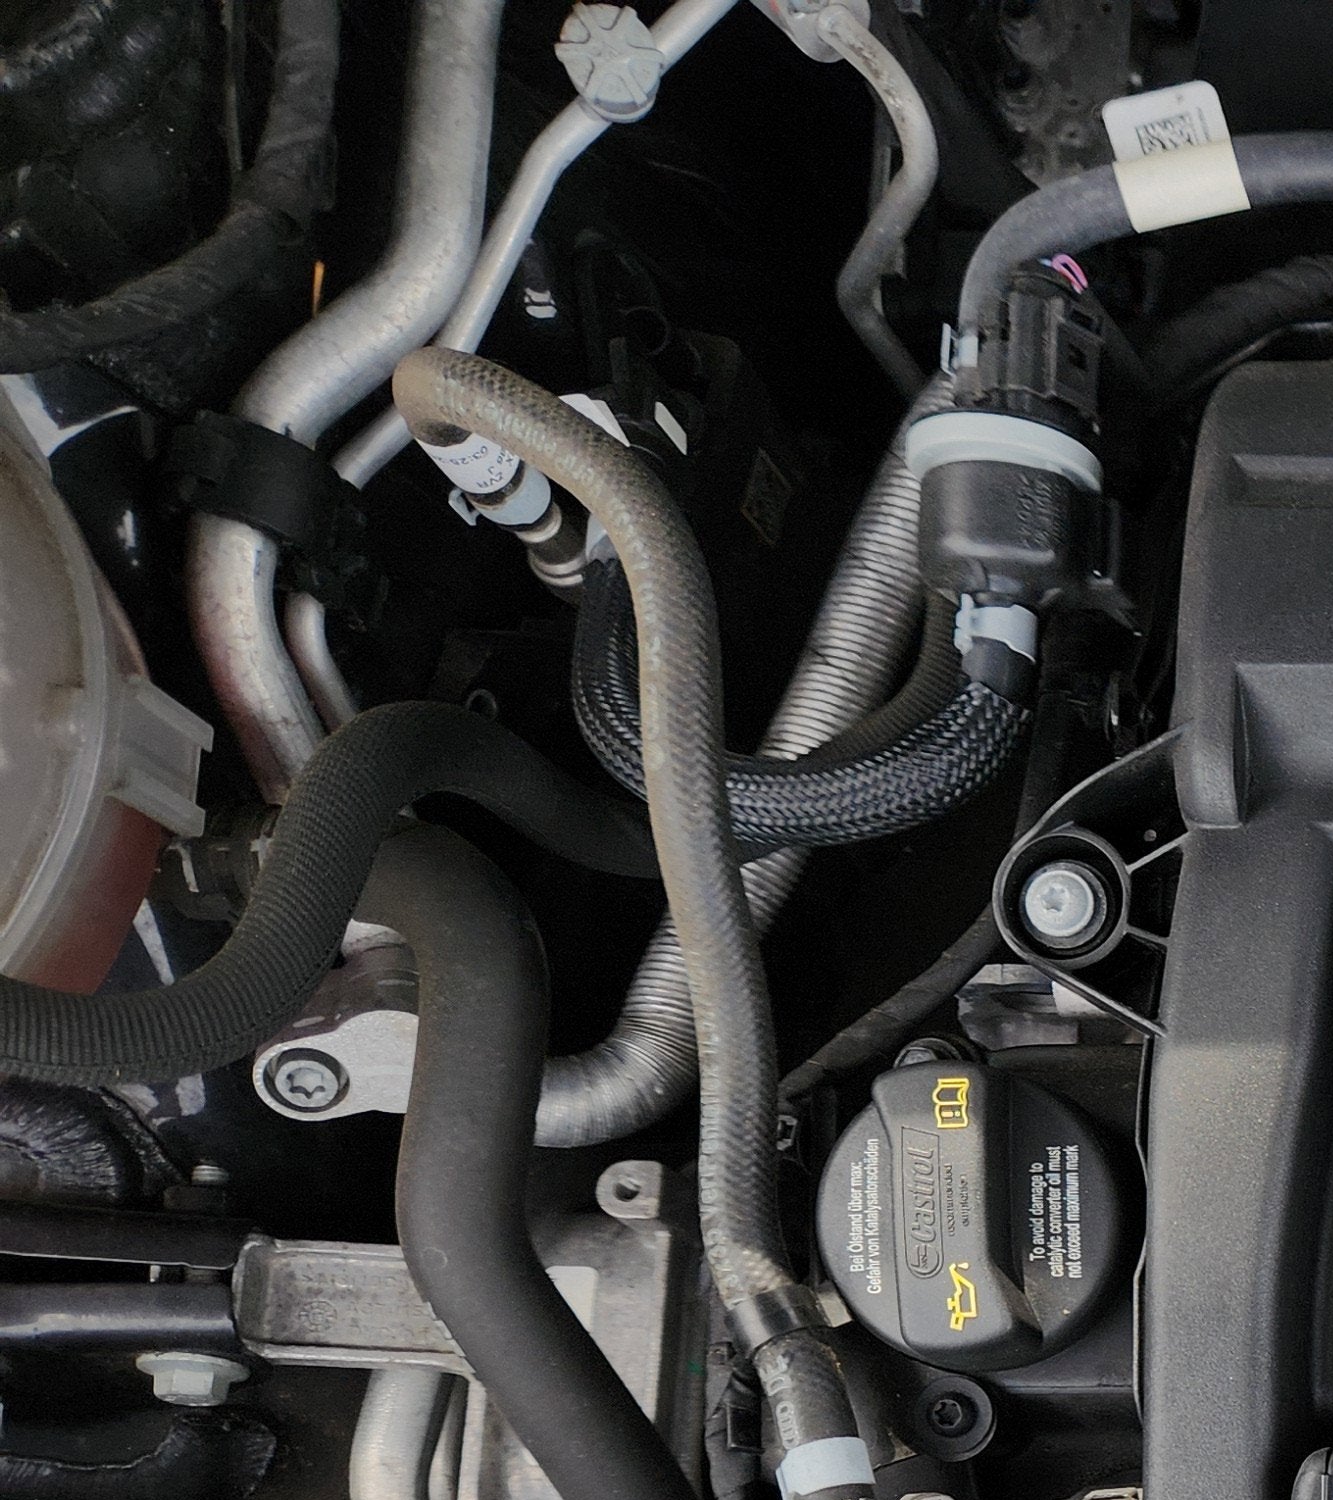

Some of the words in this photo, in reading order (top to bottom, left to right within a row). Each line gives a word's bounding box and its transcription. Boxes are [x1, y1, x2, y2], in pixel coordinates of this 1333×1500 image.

[1029, 1162, 1043, 1173] to
[1046, 1146, 1061, 1171] must
[1065, 1145, 1079, 1170] mark
[865, 1139, 882, 1236] Katalysatorschäden
[1047, 1173, 1061, 1184] oil
[848, 1188, 863, 1211] über
[906, 1146, 937, 1243] Castrol
[1030, 1175, 1047, 1215] damage
[1065, 1172, 1080, 1221] maximum
[1048, 1186, 1063, 1234] converter
[848, 1214, 864, 1253] Ölstand
[1030, 1218, 1045, 1245] avoid
[1066, 1223, 1081, 1259] exceed
[867, 1238, 880, 1257] von
[1029, 1247, 1046, 1261] To
[1049, 1236, 1066, 1277] catalytic
[850, 1255, 865, 1272] Bei
[865, 1259, 882, 1293] Gefahr
[1067, 1261, 1082, 1278] not
